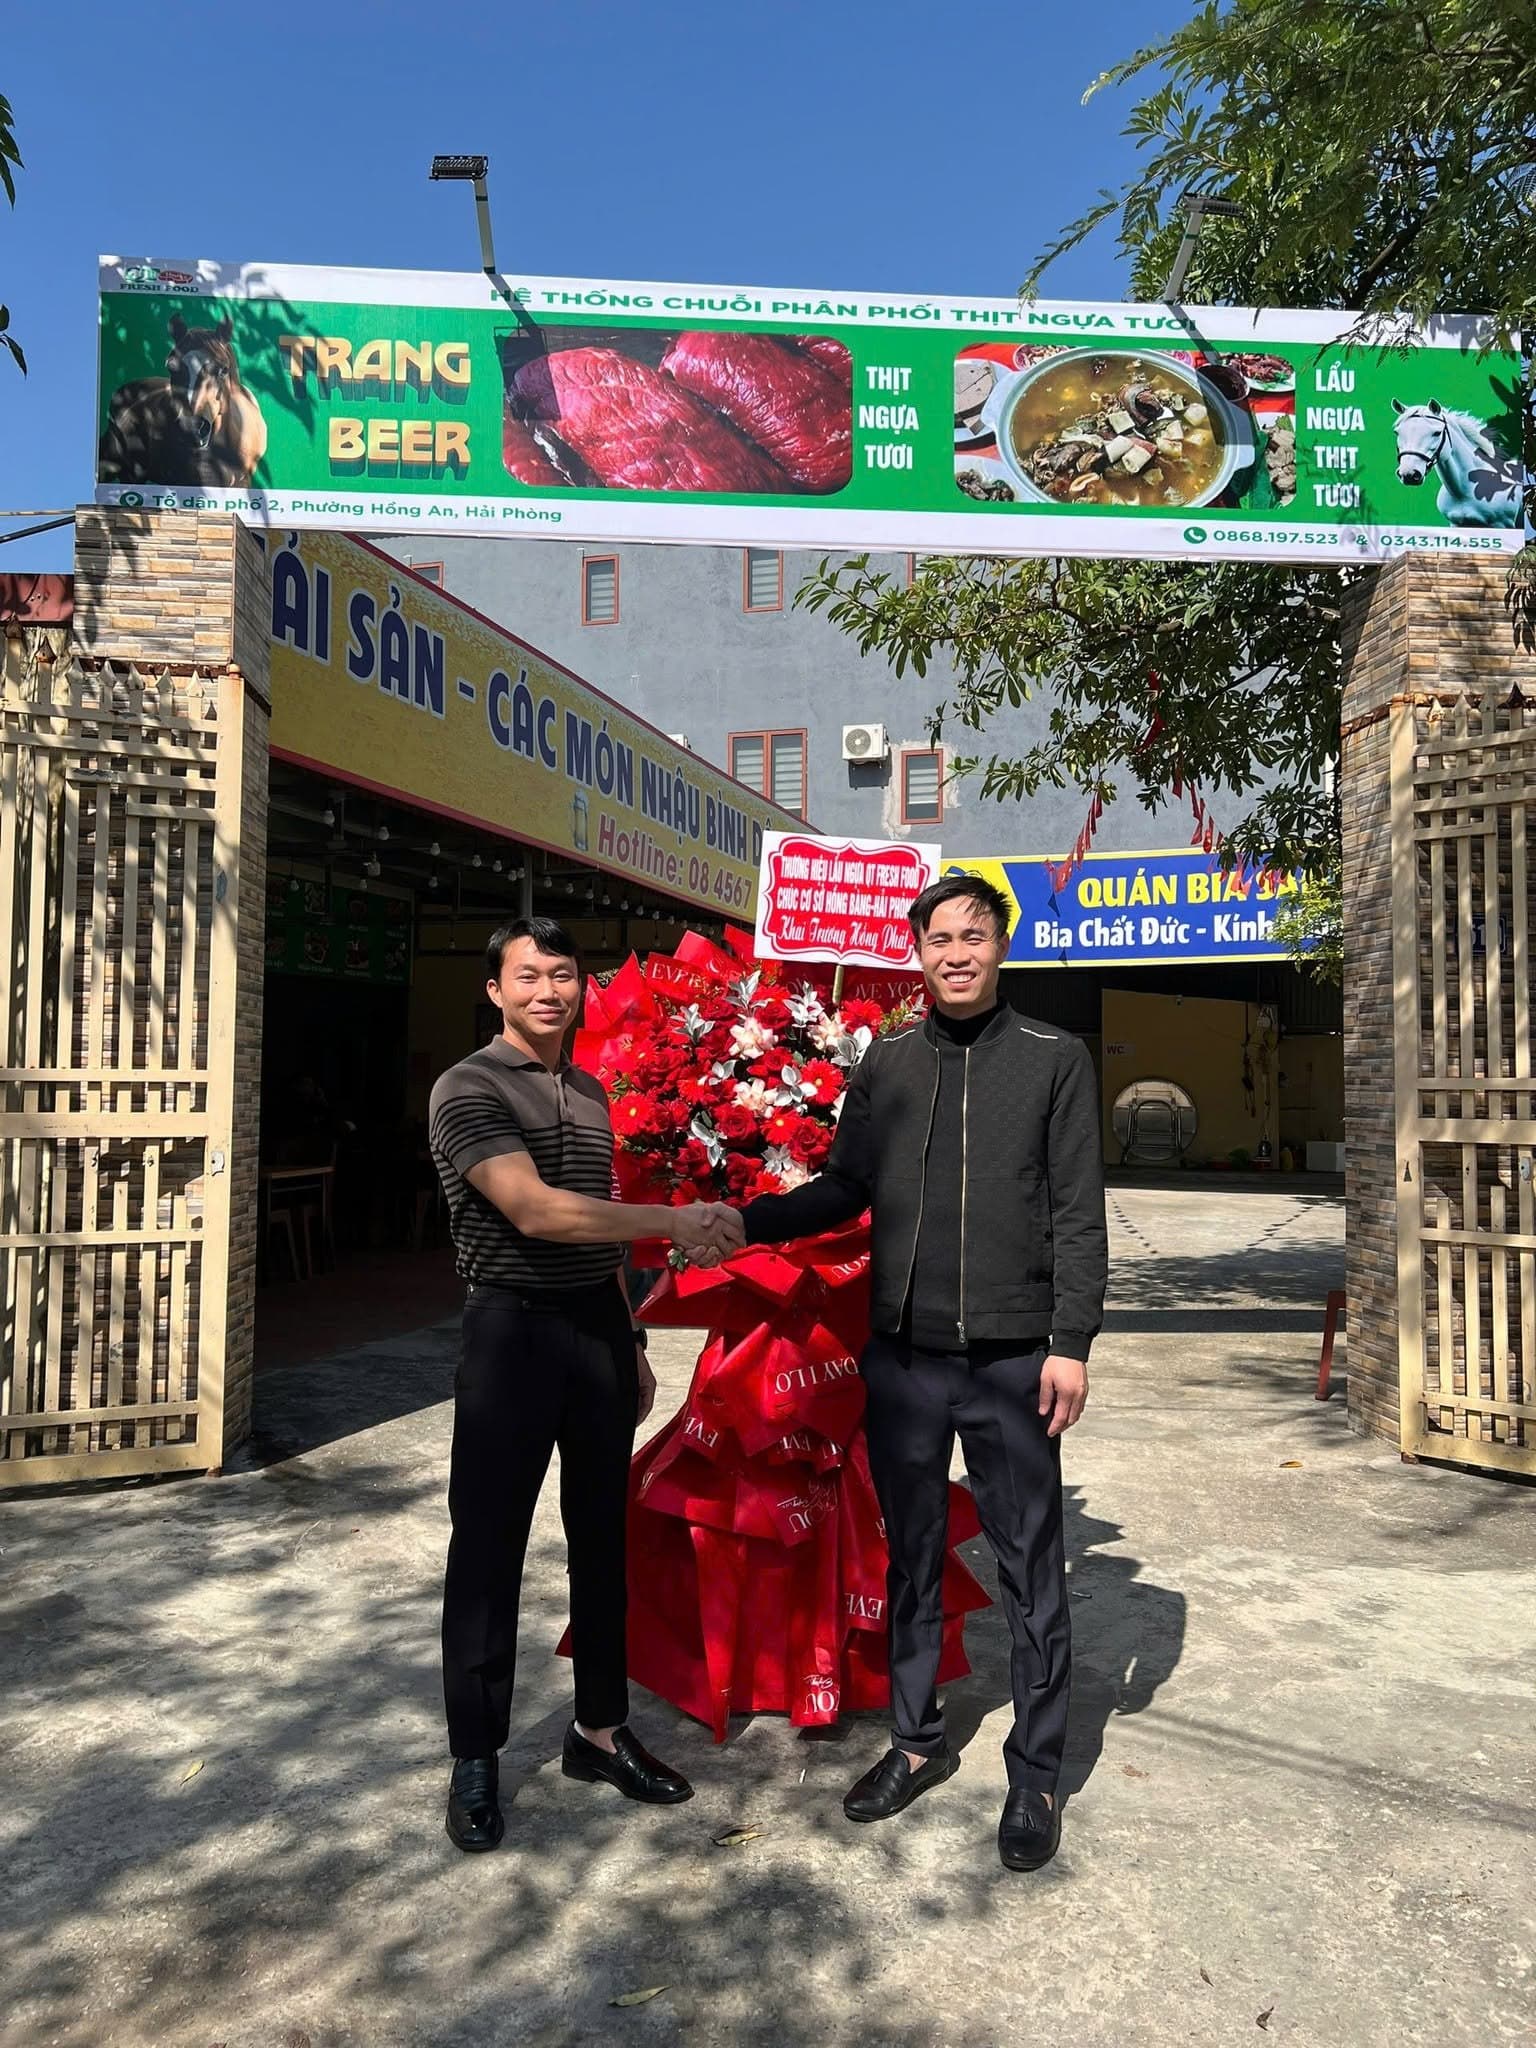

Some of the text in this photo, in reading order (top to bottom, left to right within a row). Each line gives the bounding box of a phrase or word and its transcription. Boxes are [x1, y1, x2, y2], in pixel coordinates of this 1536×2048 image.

[491, 287, 1197, 331] HỆ THỐNG CHUỖI PHÂN PHỐI THỊT NGỰA TƯƠI
[279, 336, 472, 389] TRANG
[1315, 361, 1355, 392] LẨU
[866, 366, 912, 395] THỊT
[859, 404, 919, 435] NGỰA
[1306, 406, 1365, 435] NGỰA
[329, 417, 471, 468] BEER
[864, 443, 913, 470] TƯƠI
[1314, 446, 1358, 474] THỊT
[152, 492, 177, 507] Tổ
[183, 495, 218, 508] dân
[225, 496, 262, 511] phố
[268, 500, 285, 512] 2,
[292, 499, 364, 515] Phường
[428, 504, 458, 518] An,
[466, 504, 495, 518] Hải
[503, 506, 562, 522] Phòng
[1313, 483, 1361, 508] TƯƠI
[1213, 529, 1503, 549] 0868.197.523 & 0343.114.555
[252, 530, 330, 660] ẢI
[349, 583, 444, 715] SẢN
[488, 669, 557, 769] CÁC
[565, 710, 634, 808] MÓN
[640, 756, 700, 846] NHẬU
[706, 789, 748, 862] BÌNH
[752, 815, 771, 868] D
[600, 813, 753, 910] Hotline: 08 4567
[875, 864, 900, 887] FRESH
[899, 866, 920, 889] FOOD
[1077, 867, 1178, 909] QUÁN
[1187, 870, 1248, 904] BIA
[778, 915, 806, 941] Khai
[1034, 920, 1073, 949] Bia
[1078, 915, 1136, 948] Chất
[1141, 915, 1191, 946] Đức
[1213, 910, 1275, 943] Kính
[1105, 1045, 1125, 1055] WC
